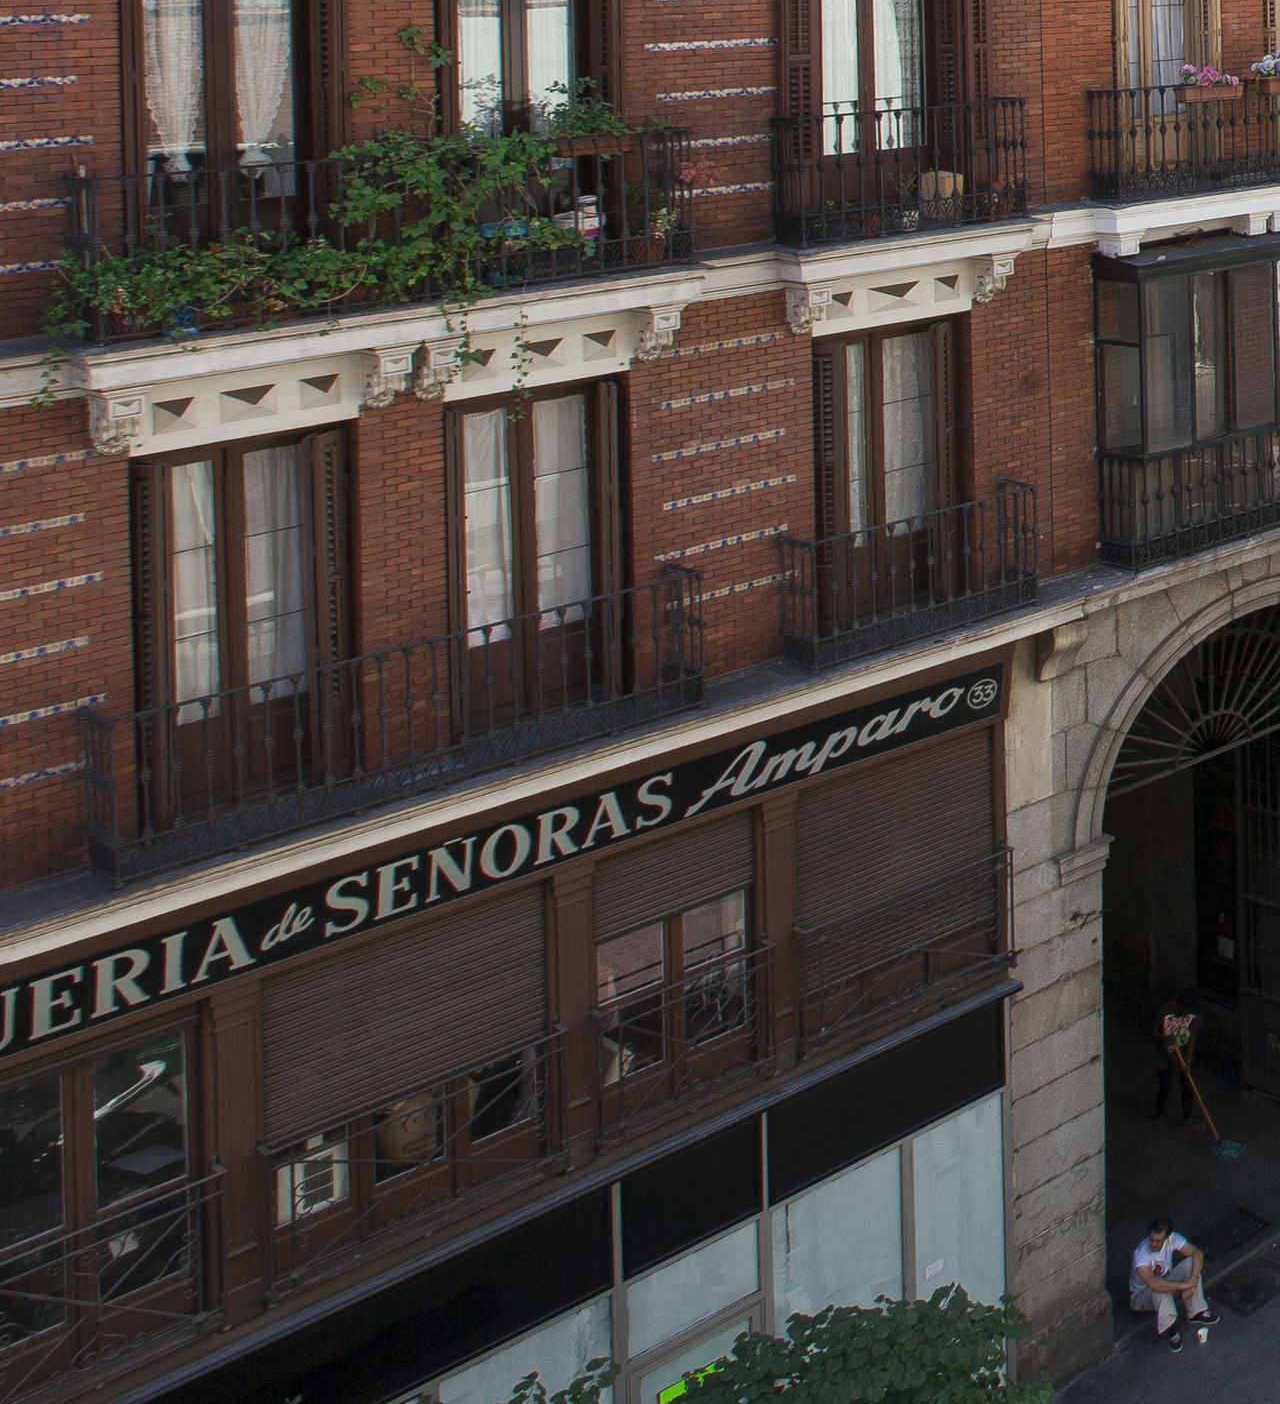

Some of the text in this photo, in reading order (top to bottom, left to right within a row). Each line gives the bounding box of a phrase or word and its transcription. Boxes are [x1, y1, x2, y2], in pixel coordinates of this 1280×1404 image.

[260, 902, 316, 951] de
[324, 772, 674, 937] SEÑORAS
[684, 686, 965, 818] Amparo
[971, 680, 994, 703] 33
